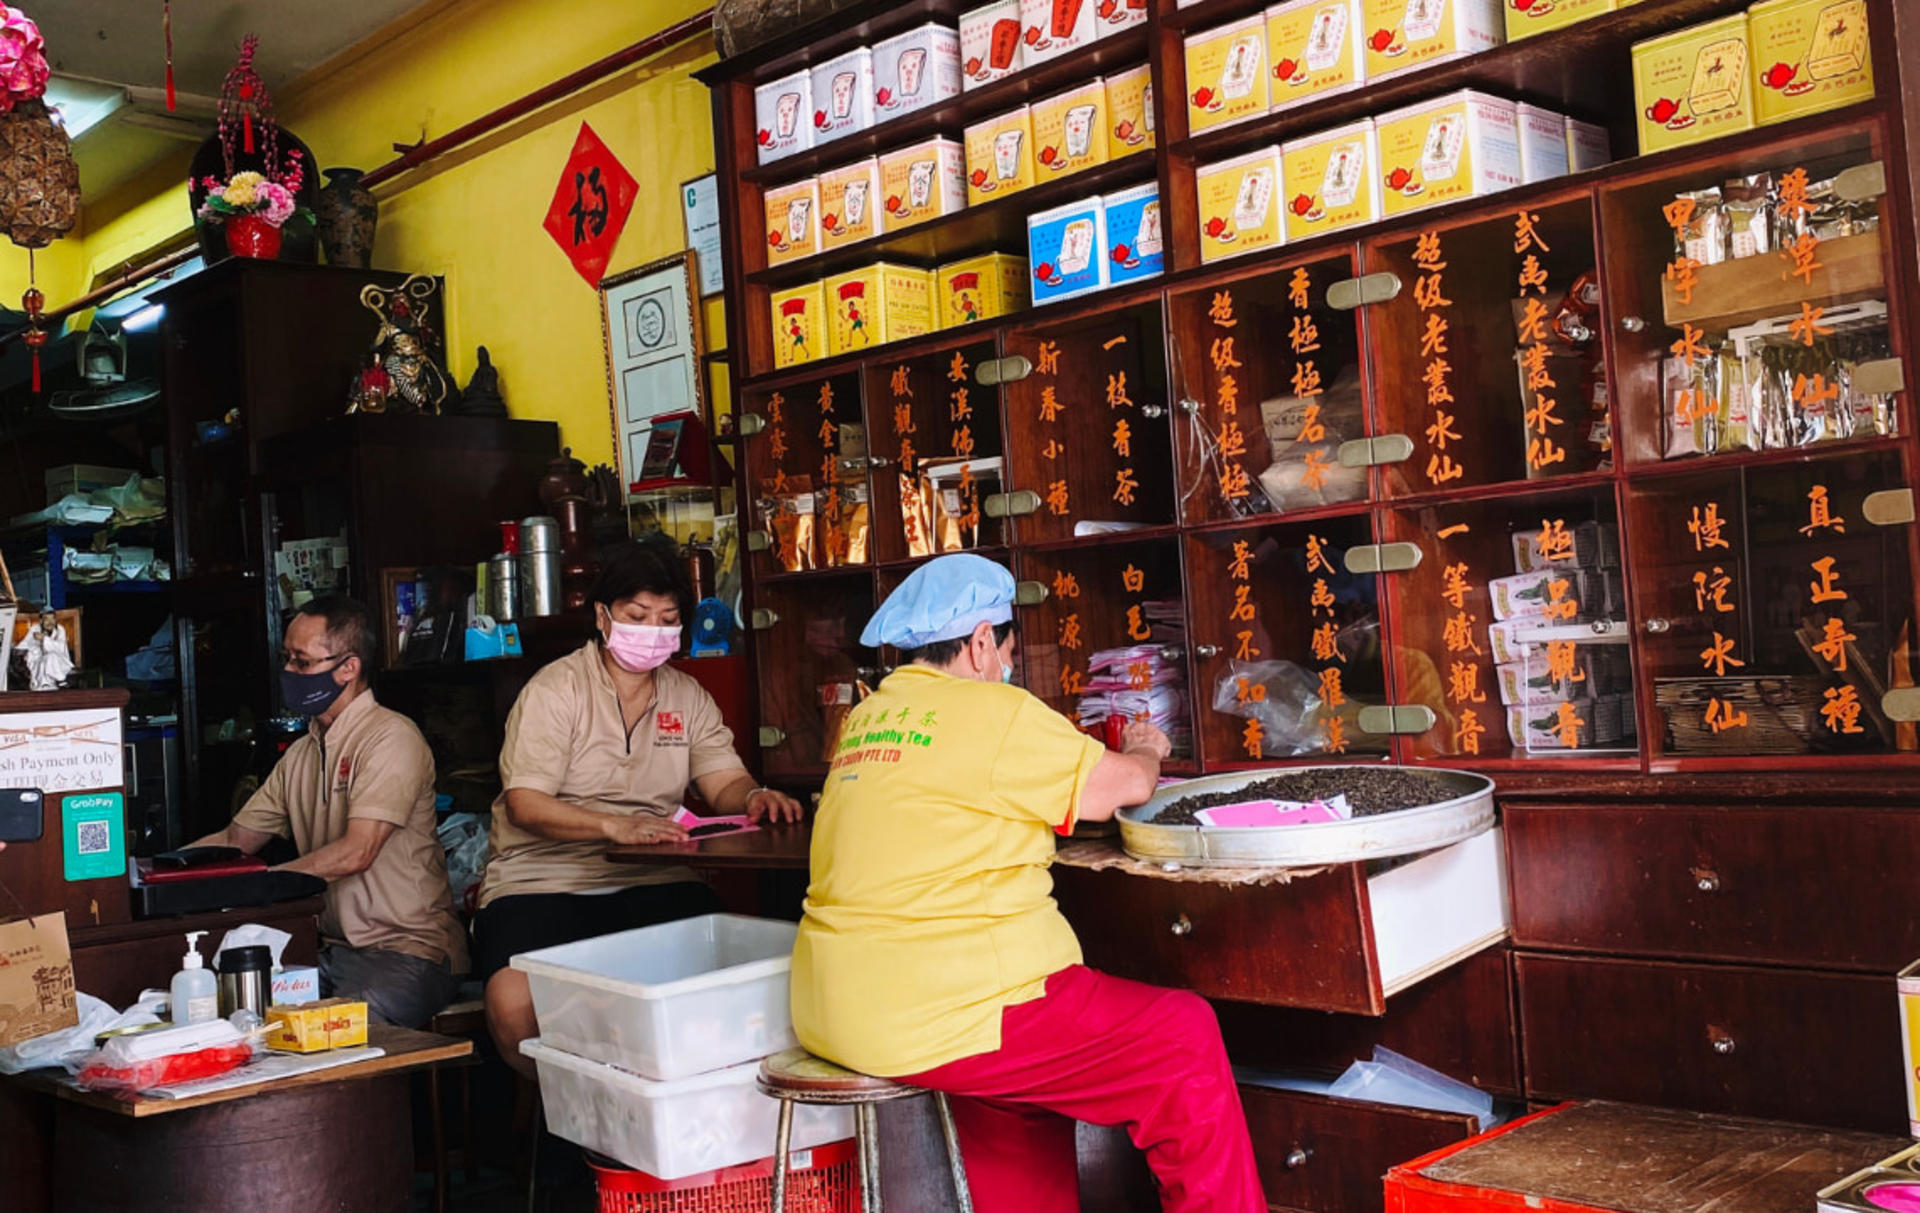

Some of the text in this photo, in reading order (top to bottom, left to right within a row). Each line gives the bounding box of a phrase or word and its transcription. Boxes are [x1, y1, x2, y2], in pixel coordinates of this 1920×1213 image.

[907, 730, 933, 747] Tea
[20, 756, 79, 772] Payment
[84, 751, 115, 766] Only
